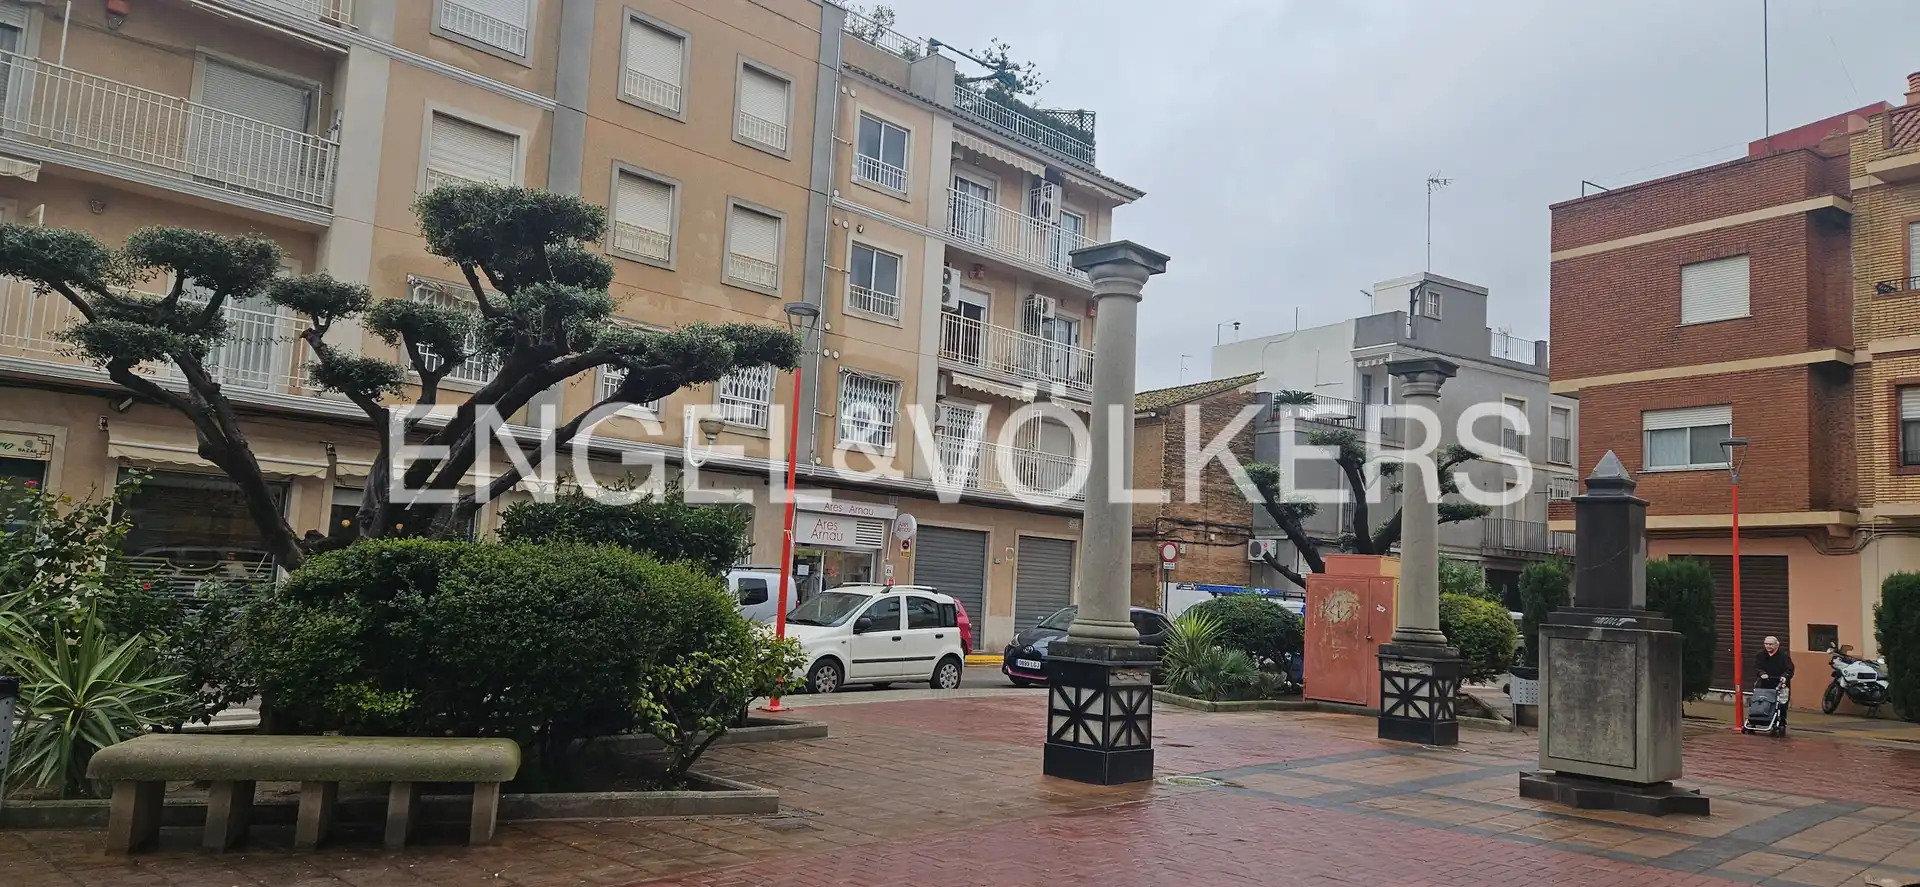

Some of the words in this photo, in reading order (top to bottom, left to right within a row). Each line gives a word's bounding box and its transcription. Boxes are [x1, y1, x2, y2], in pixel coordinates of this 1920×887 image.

[824, 503, 842, 512] Ares
[849, 506, 874, 515] Arnau
[815, 518, 838, 531] Ares
[811, 530, 843, 542] Arnau
